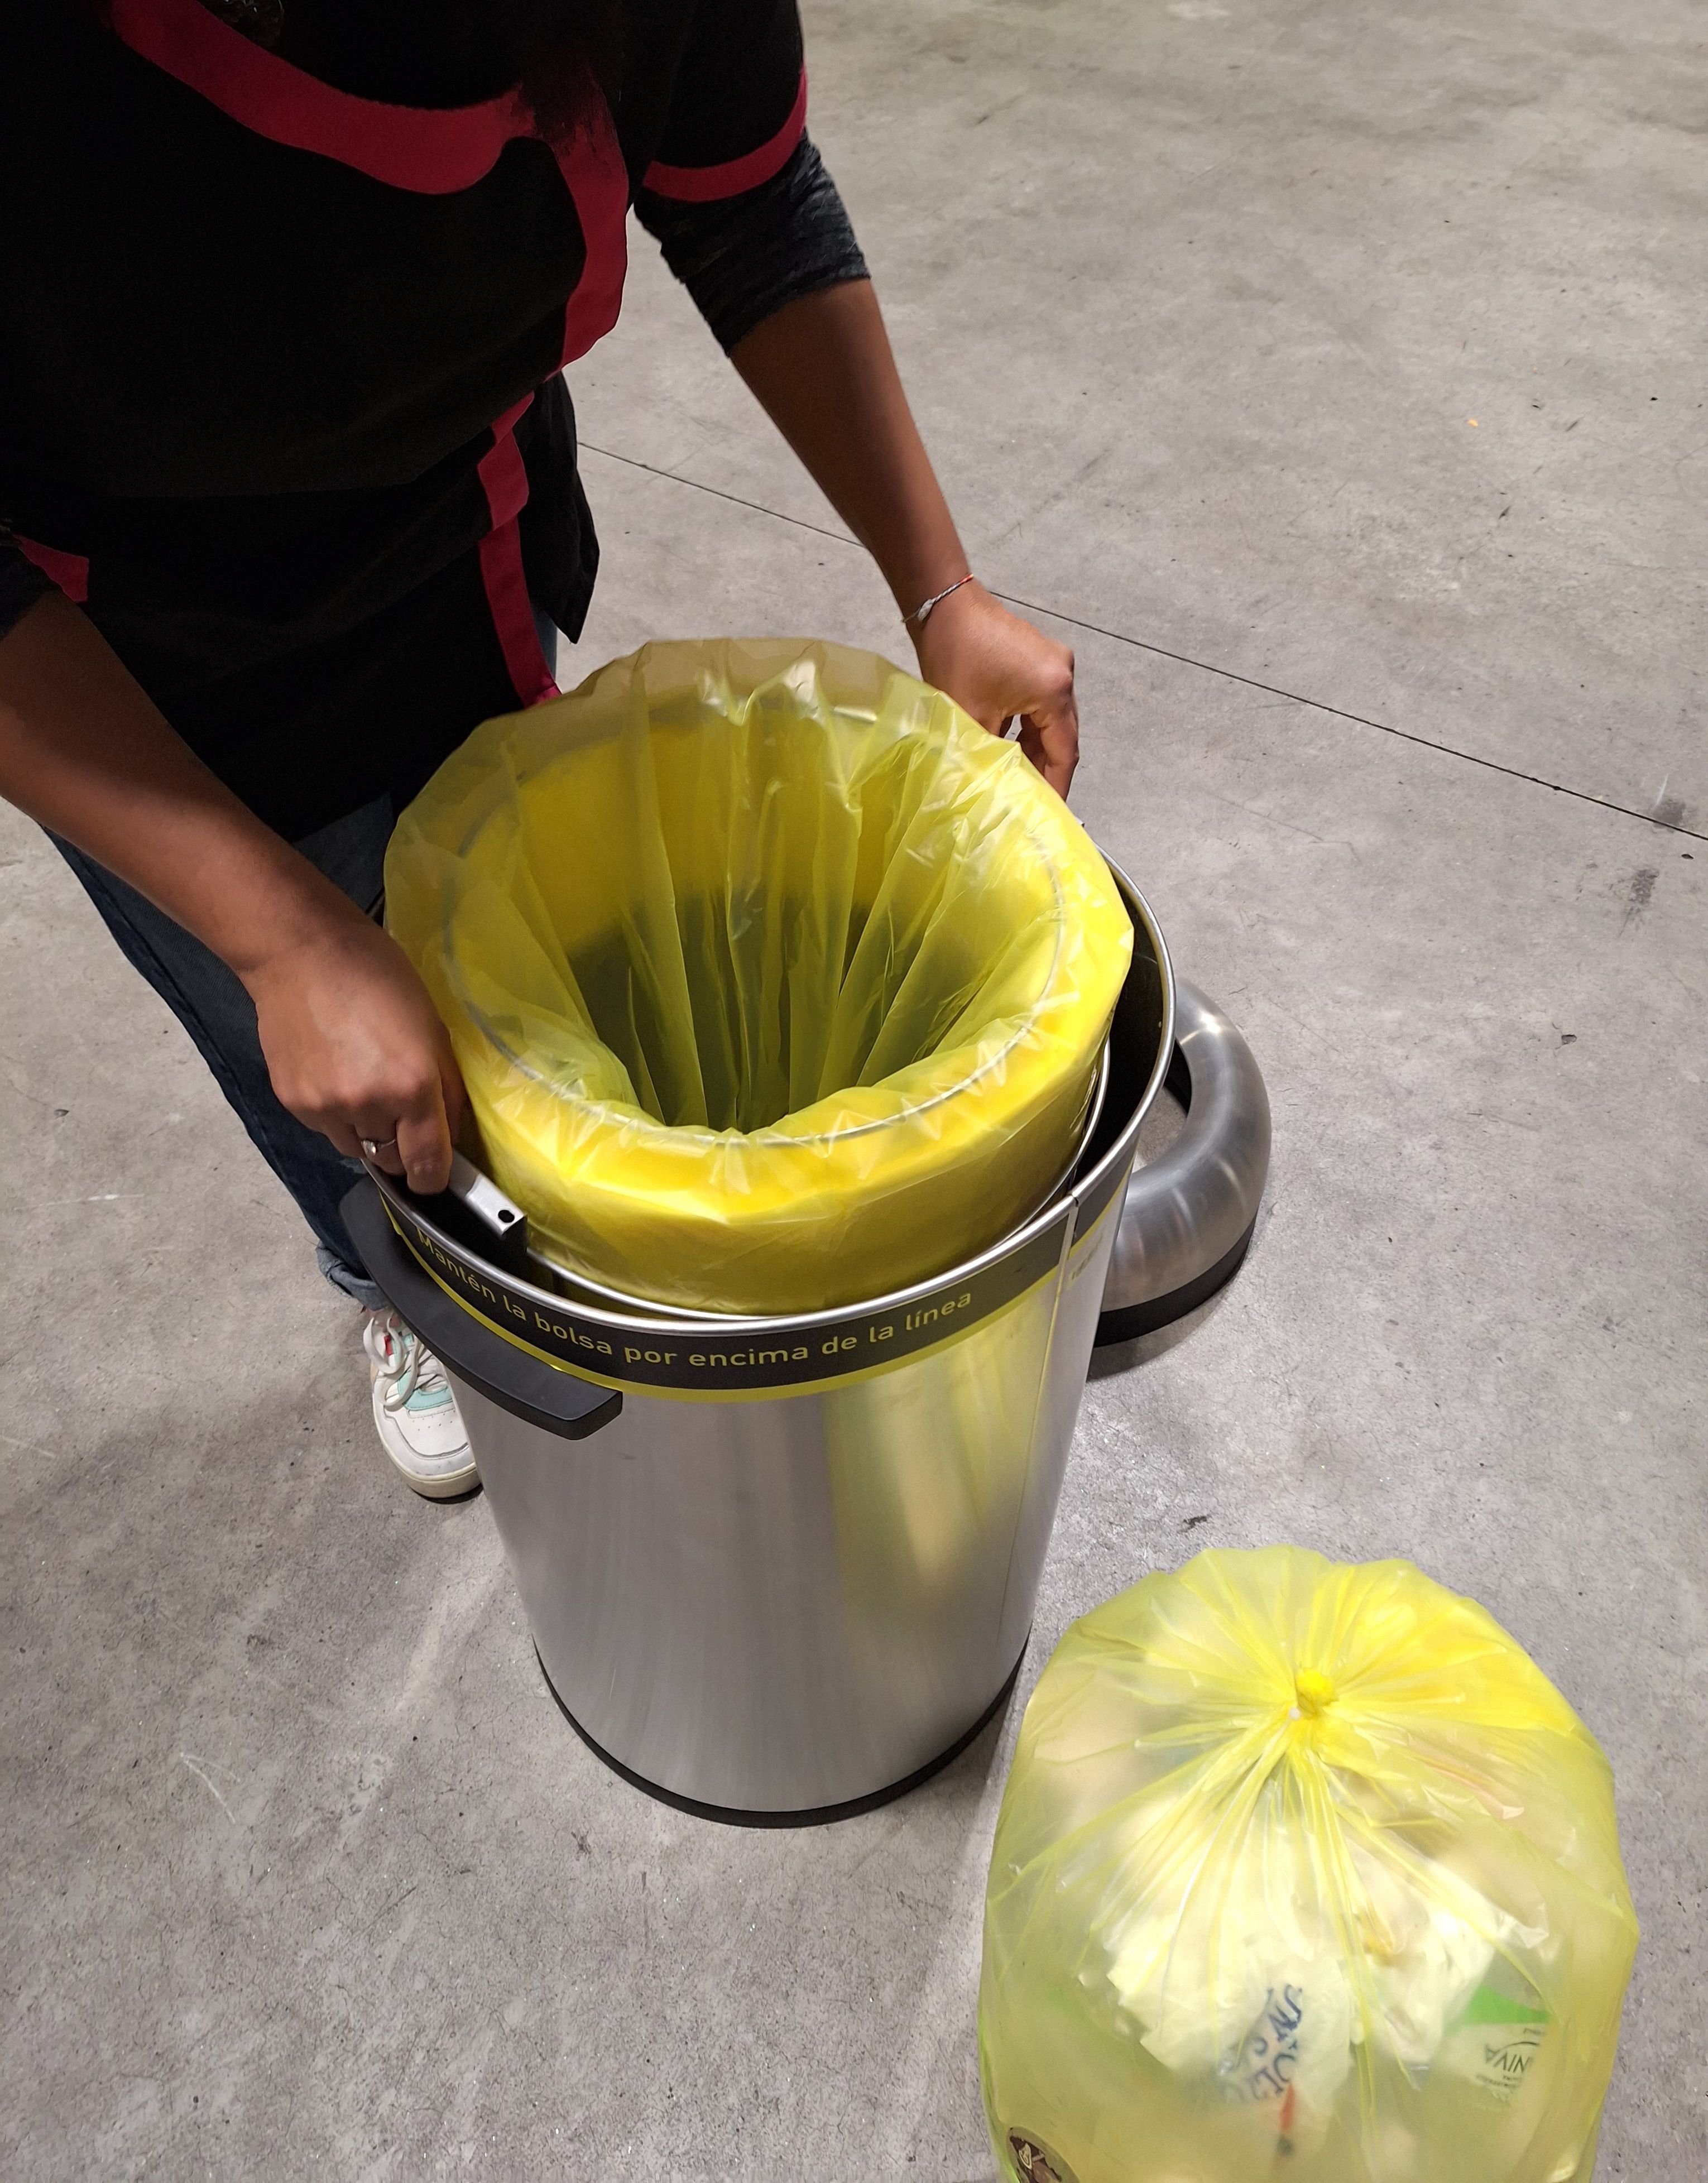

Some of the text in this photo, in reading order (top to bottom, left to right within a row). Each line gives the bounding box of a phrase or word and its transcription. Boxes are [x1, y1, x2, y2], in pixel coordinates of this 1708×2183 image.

[417, 1227, 971, 1367] Mantén la bolsa por encima de la línea
